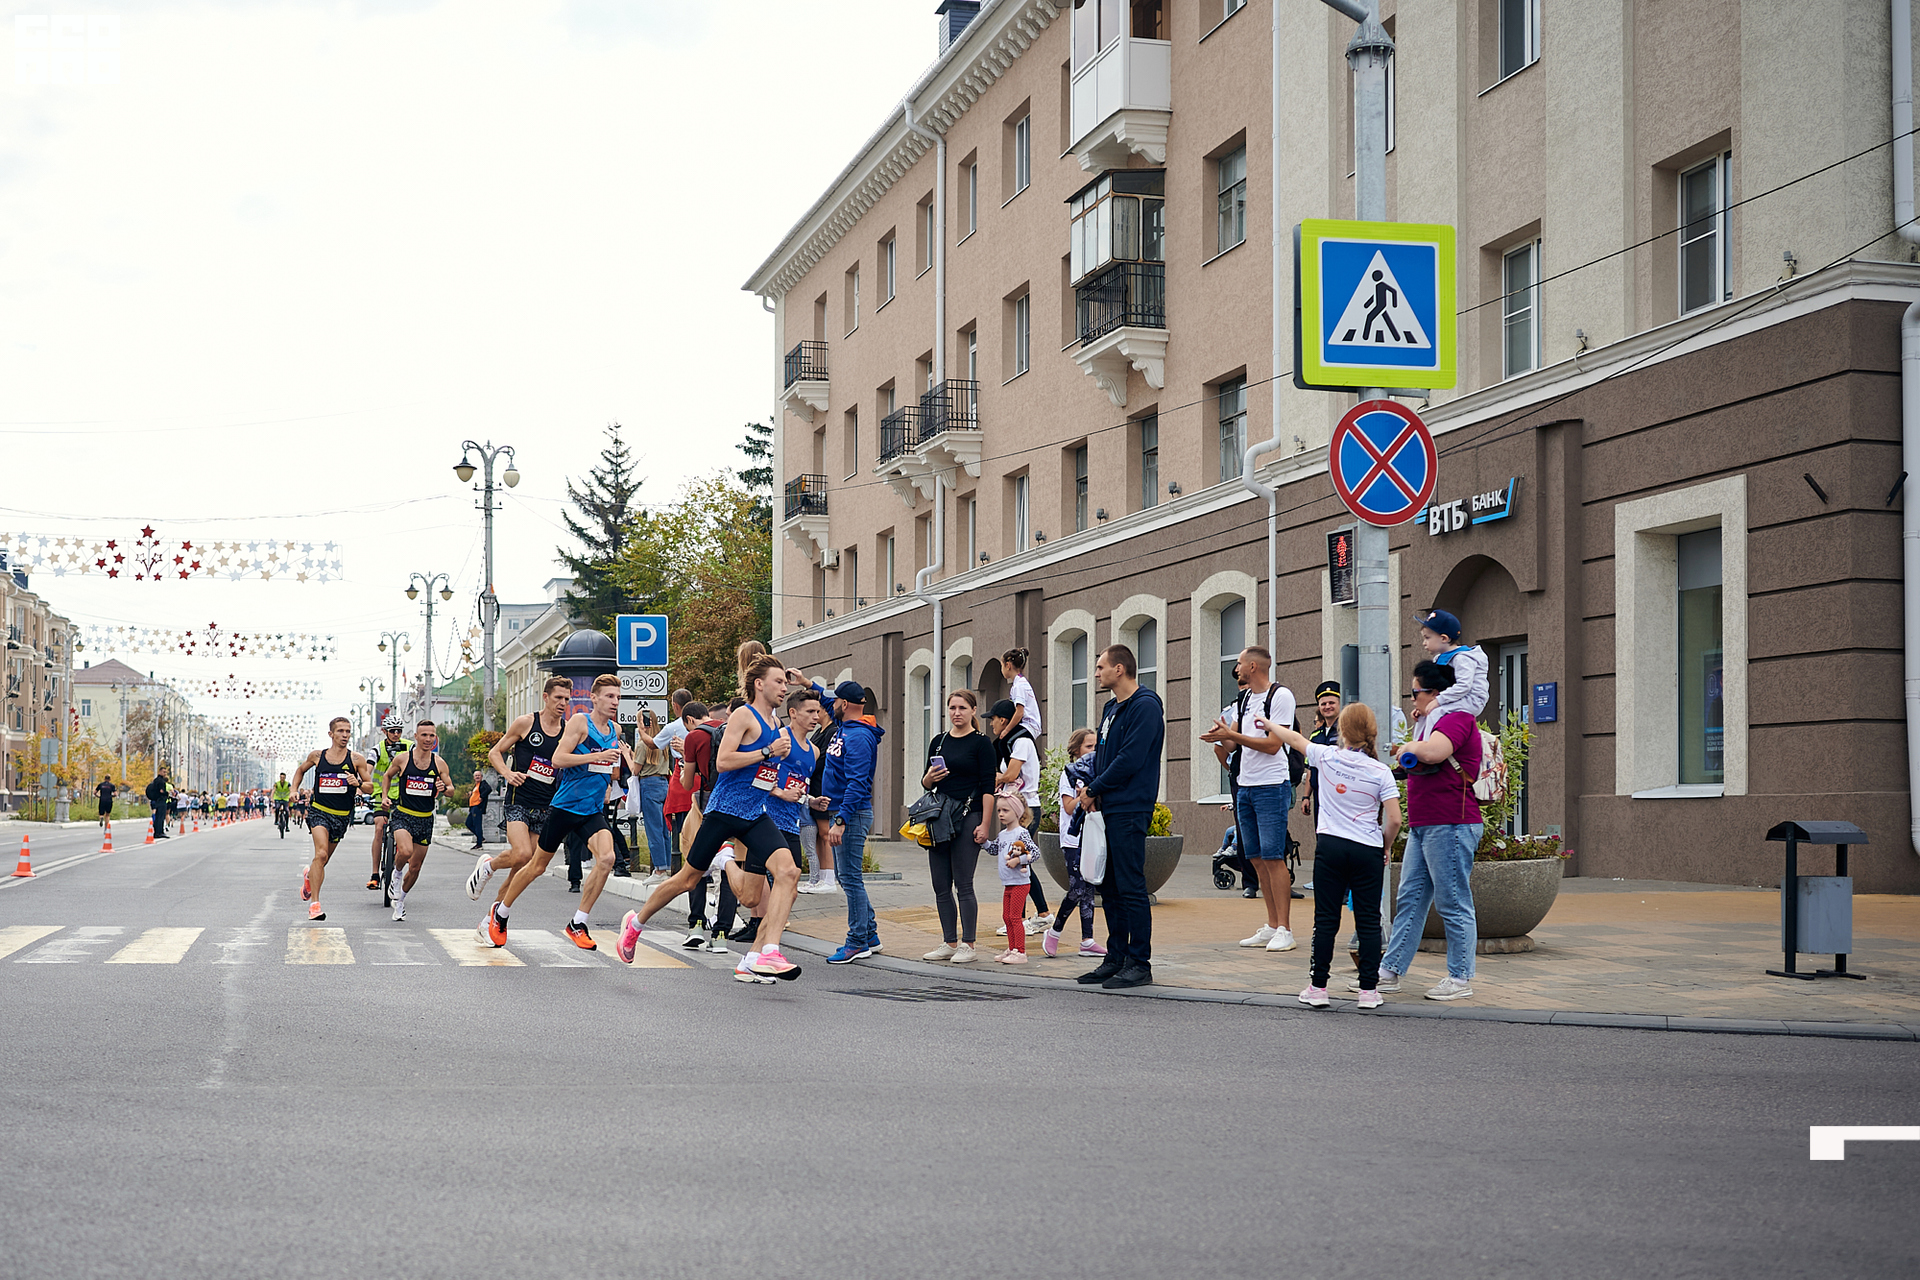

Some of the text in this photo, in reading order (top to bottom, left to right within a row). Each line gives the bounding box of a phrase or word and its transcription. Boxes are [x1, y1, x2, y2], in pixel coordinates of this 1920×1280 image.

[1429, 489, 1507, 536] ВТБ БАНК
[630, 622, 657, 661] P
[622, 678, 661, 688] 10 15 20
[620, 713, 637, 723] 8.00
[531, 762, 554, 776] 2003
[321, 779, 342, 787] 2326
[407, 781, 429, 790] 2000
